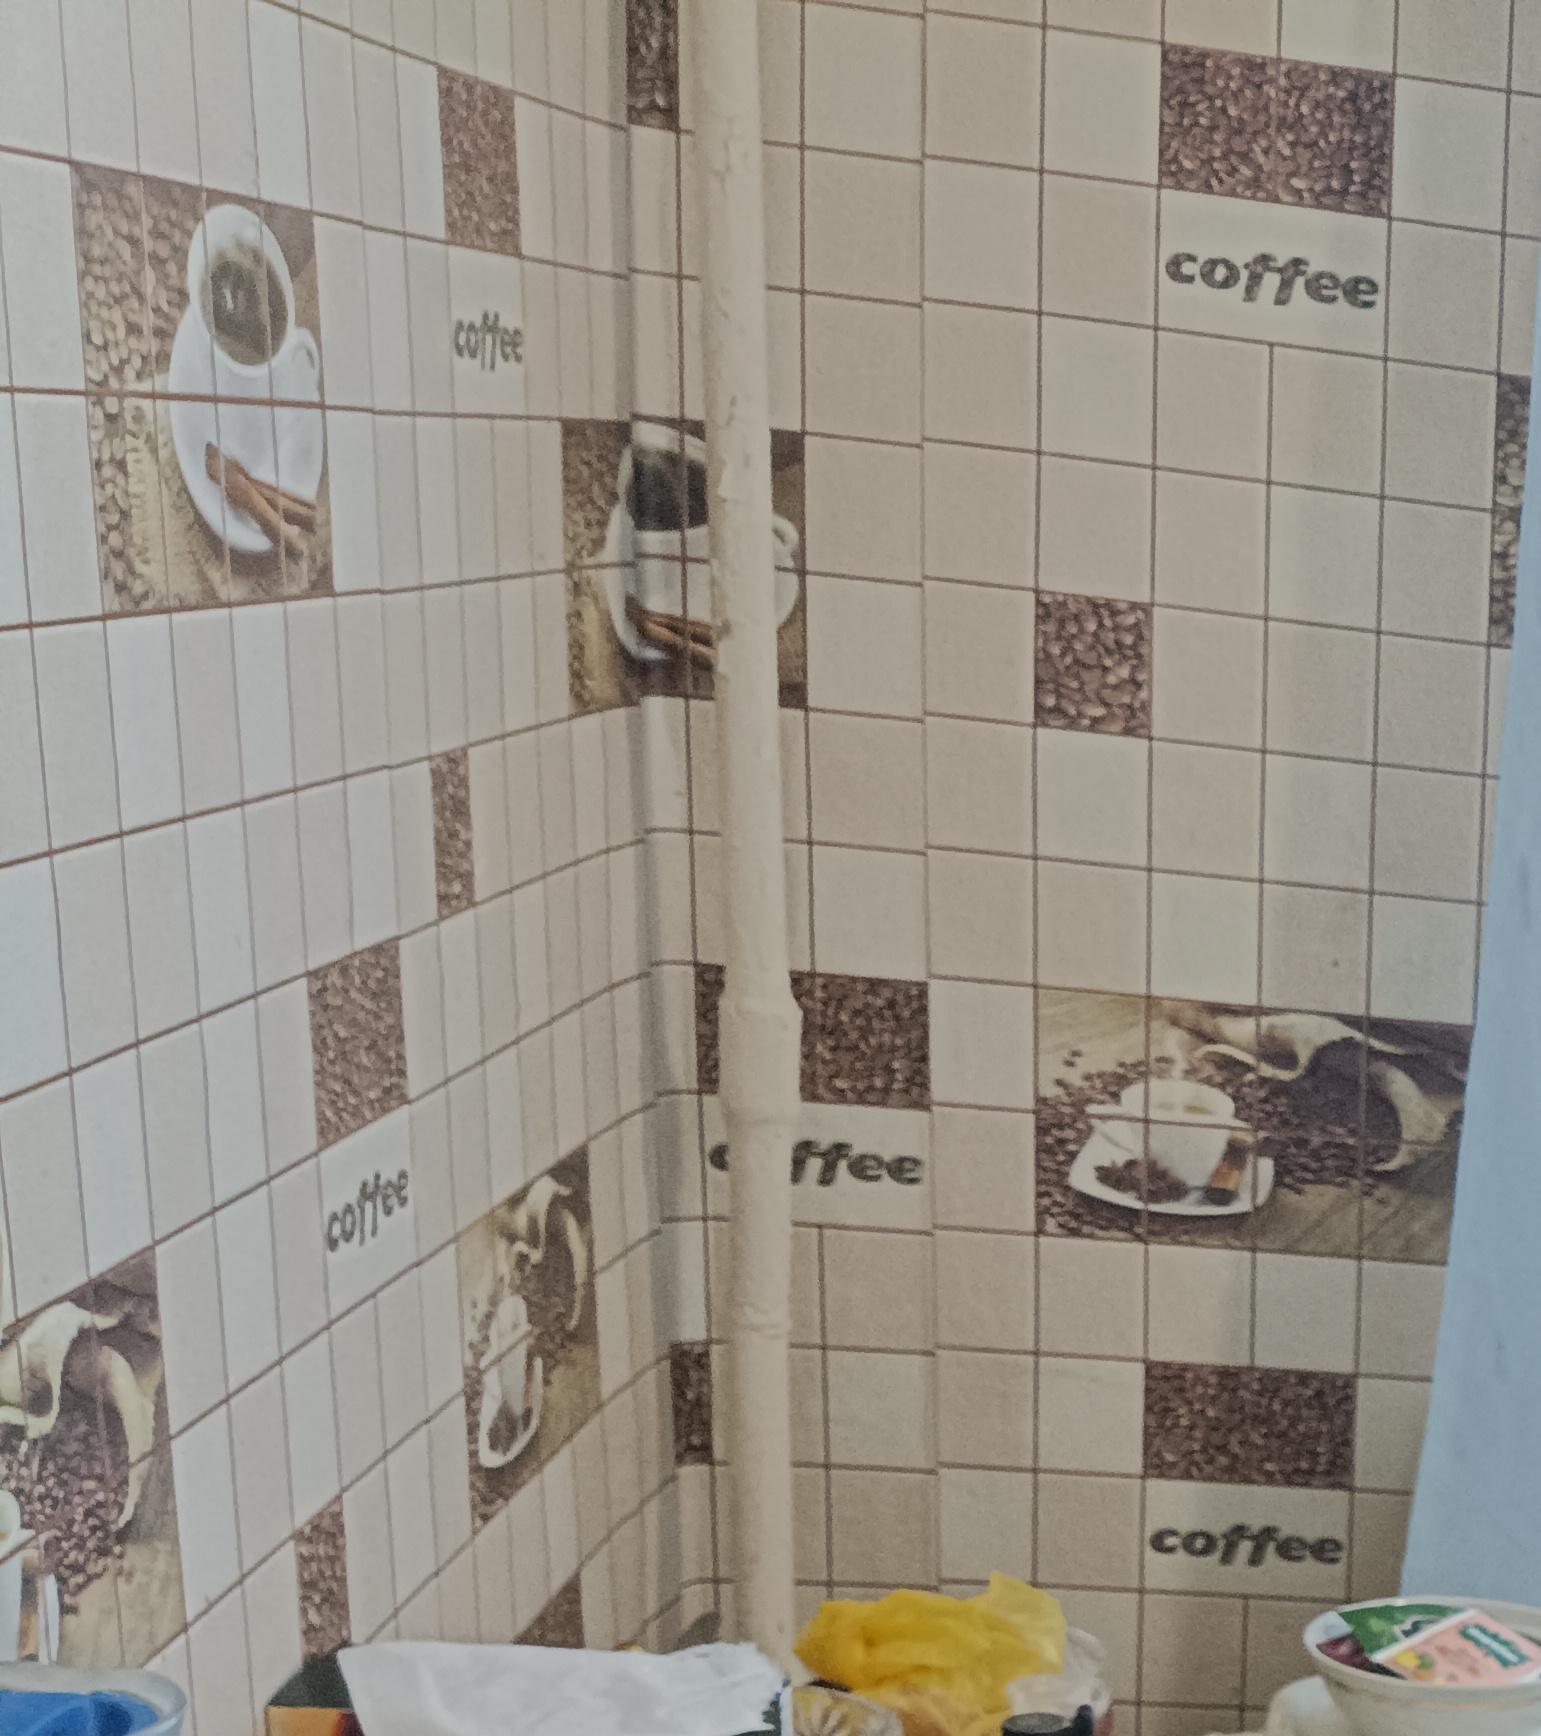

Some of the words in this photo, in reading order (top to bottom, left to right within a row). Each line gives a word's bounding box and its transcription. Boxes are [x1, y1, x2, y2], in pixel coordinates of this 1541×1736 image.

[1164, 251, 1380, 309] coffee
[453, 309, 523, 373] coffee
[707, 1138, 924, 1188] cffee
[326, 1169, 409, 1253] coffee
[1149, 1523, 1344, 1569] coffee
